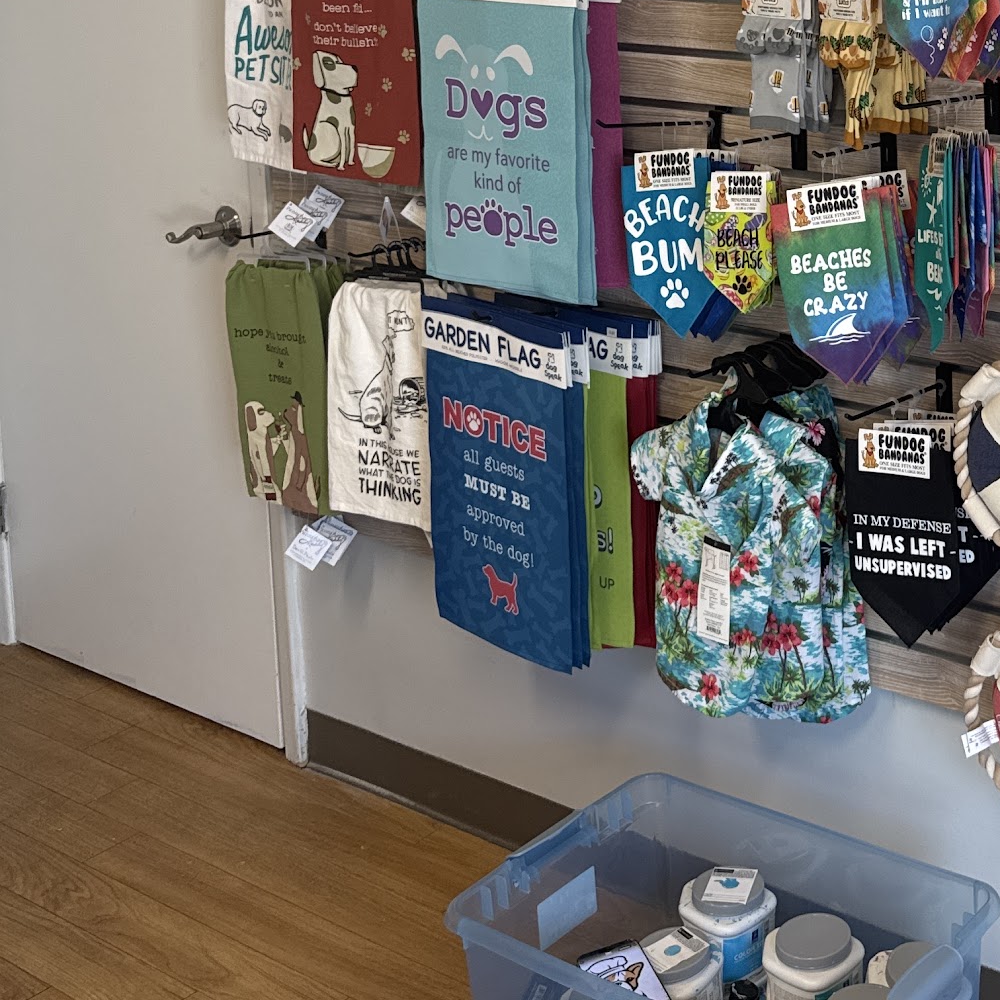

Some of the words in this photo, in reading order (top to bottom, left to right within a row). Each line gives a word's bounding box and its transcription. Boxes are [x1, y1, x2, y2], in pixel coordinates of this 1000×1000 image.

[322, 2, 350, 13] been
[902, 8, 911, 20] if
[914, 8, 920, 19] I
[923, 6, 944, 18] want
[314, 22, 341, 32] don't
[313, 35, 339, 46] their
[235, 55, 270, 81] PET
[447, 147, 468, 162] are
[471, 150, 491, 167] my
[495, 148, 551, 173] favorite
[650, 151, 690, 167] FUNDOG
[651, 164, 691, 177] BANDANAS
[474, 172, 503, 192] kind
[507, 177, 522, 194] of
[807, 184, 857, 204] FUNDOG
[624, 194, 706, 239] BEACH
[809, 199, 858, 216] BANDANAS
[717, 228, 759, 248] BEACH
[631, 237, 704, 276] BUM
[715, 250, 763, 271] PLEASE
[790, 248, 872, 275] BEACHES
[823, 271, 848, 293] BE
[803, 291, 869, 317] CRAZY
[234, 328, 263, 338] hope
[424, 316, 491, 354] GARDEN
[497, 336, 541, 369] FLAG
[544, 369, 563, 382] Speak
[545, 362, 558, 374] dog
[442, 396, 548, 463] NOTICE
[359, 438, 368, 446] IN
[370, 439, 387, 449] THIS
[407, 450, 420, 458] WE
[878, 433, 925, 452] FUNDOG
[358, 450, 421, 476] NARRATE
[463, 449, 480, 466] all
[484, 454, 526, 481] guests
[878, 448, 925, 465] BANDANAS
[359, 467, 384, 477] WHAT
[395, 474, 412, 485] DOG
[414, 478, 421, 487] IS
[358, 478, 422, 505] THINKING
[464, 473, 508, 501] MUST
[511, 492, 531, 511] BE
[466, 504, 526, 537] approved
[853, 514, 869, 526] IN
[871, 515, 890, 528] MY
[893, 517, 951, 534] DEFENSE
[463, 526, 480, 547] by
[482, 534, 503, 555] the
[507, 543, 535, 568] dog!
[856, 533, 863, 549] I
[869, 534, 905, 554] WAS
[910, 538, 946, 558] LEFT
[854, 555, 951, 581] UNSUPERVISED
